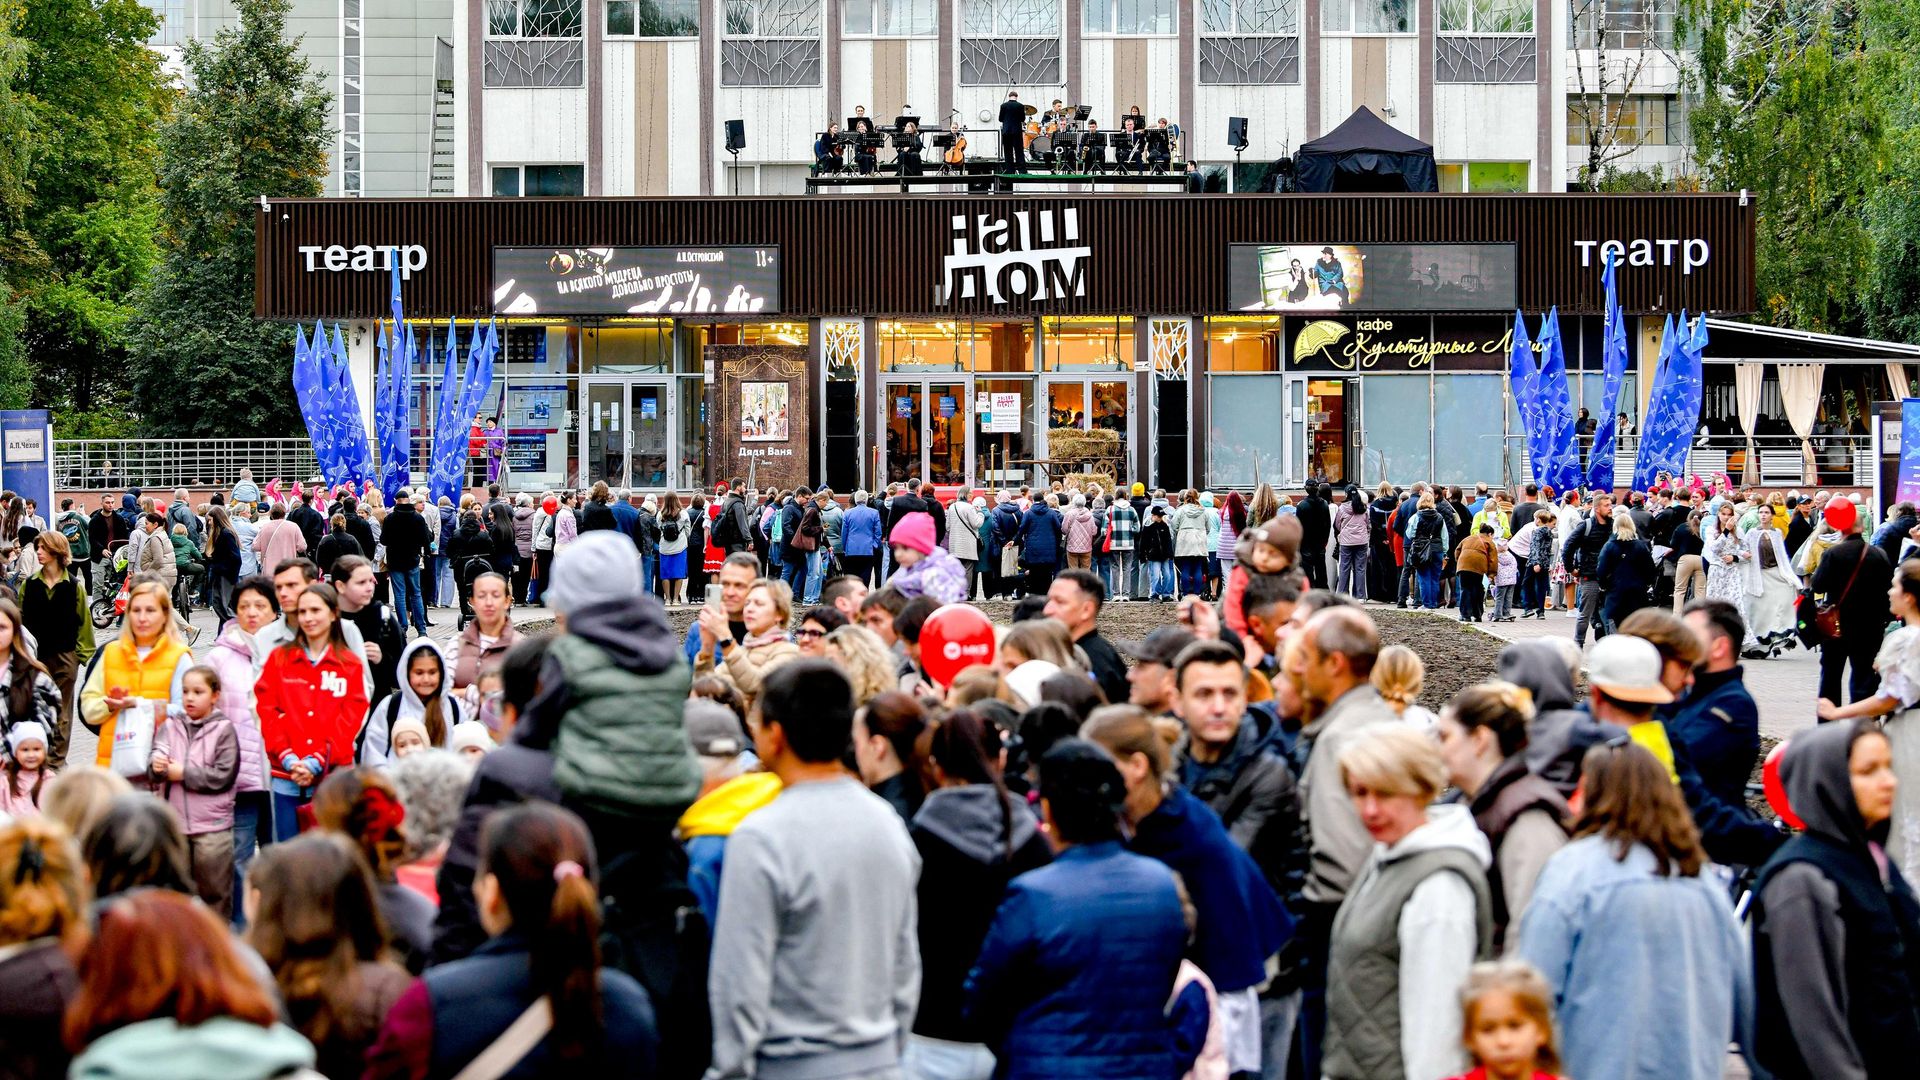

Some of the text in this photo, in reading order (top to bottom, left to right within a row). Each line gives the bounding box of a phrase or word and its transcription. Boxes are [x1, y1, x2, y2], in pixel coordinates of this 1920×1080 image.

[299, 245, 427, 280] театр
[755, 250, 774, 267] 18+
[1574, 239, 1709, 274] театр
[556, 266, 643, 294] НА ВСЯКОГО МУДРЕЦА
[612, 269, 694, 299] ДОВОЛЬНО ПРОСТОТЫ
[1356, 318, 1393, 333] кафе
[1344, 333, 1478, 368] Культурные
[738, 446, 792, 456] Дядя Ваня
